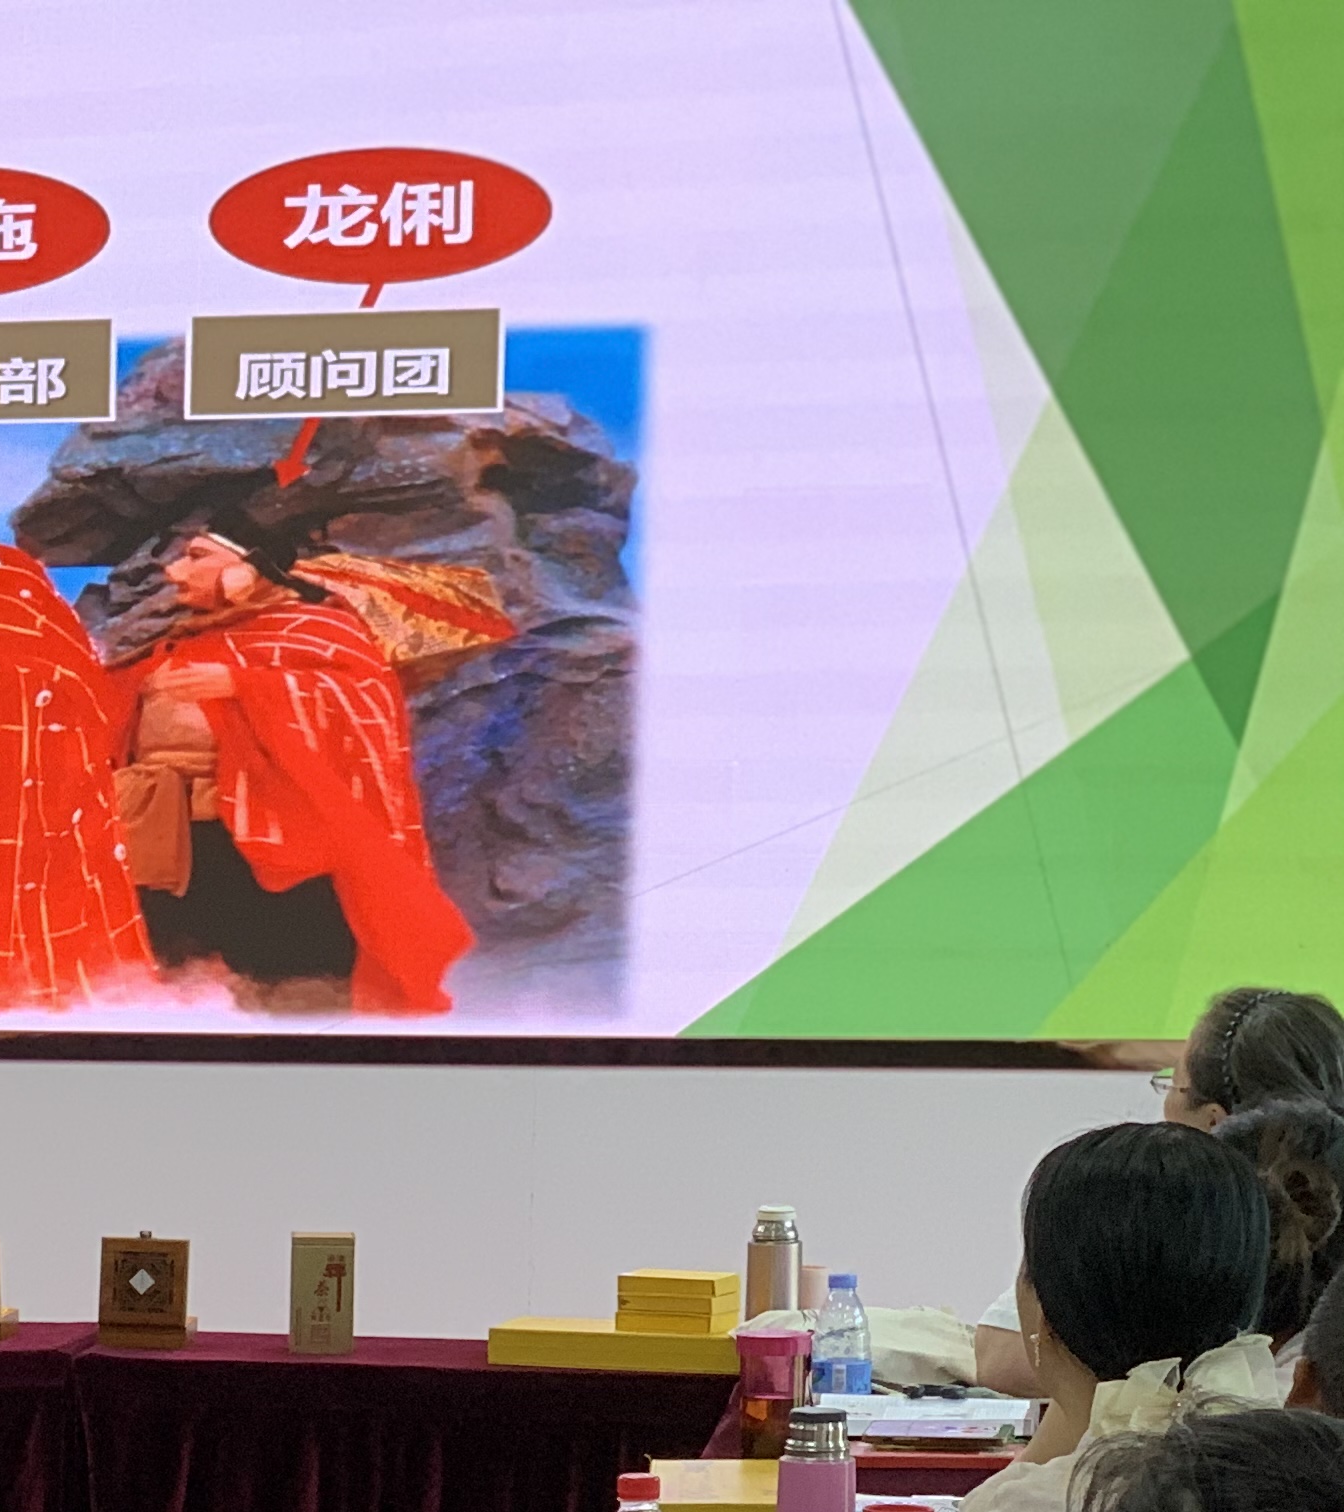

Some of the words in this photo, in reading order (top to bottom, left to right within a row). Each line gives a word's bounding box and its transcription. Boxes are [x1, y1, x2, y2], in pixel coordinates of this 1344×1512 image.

[282, 179, 474, 248] 龙俐
[235, 347, 451, 400] 顾问团
